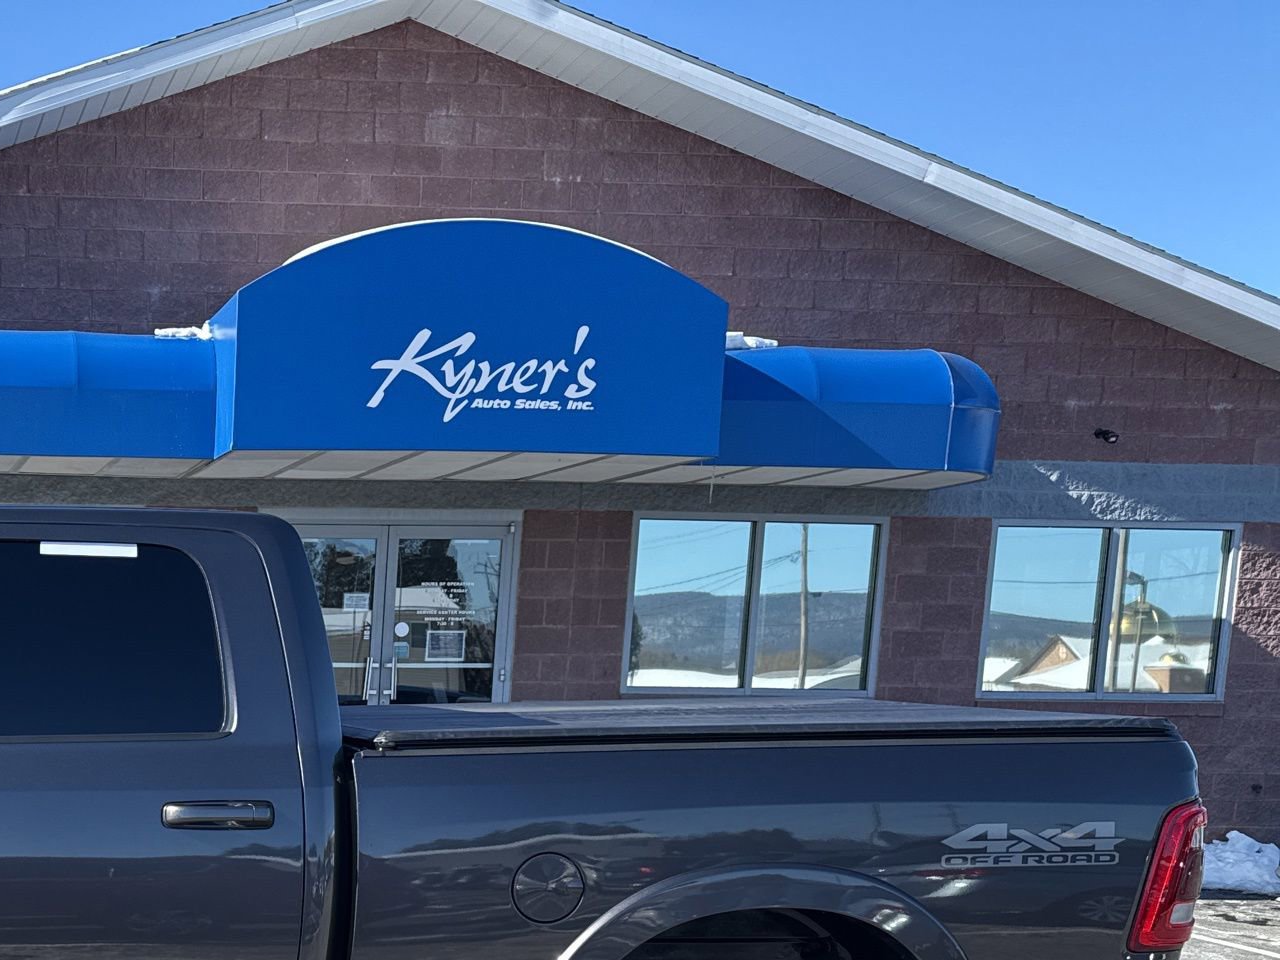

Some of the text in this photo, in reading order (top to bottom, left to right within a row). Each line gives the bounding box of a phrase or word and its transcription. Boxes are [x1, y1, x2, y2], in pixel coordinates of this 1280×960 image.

[366, 325, 597, 423] Kyner's
[470, 398, 595, 411] Auto Sales, Inc.
[944, 852, 1117, 867] OFF ROAD
